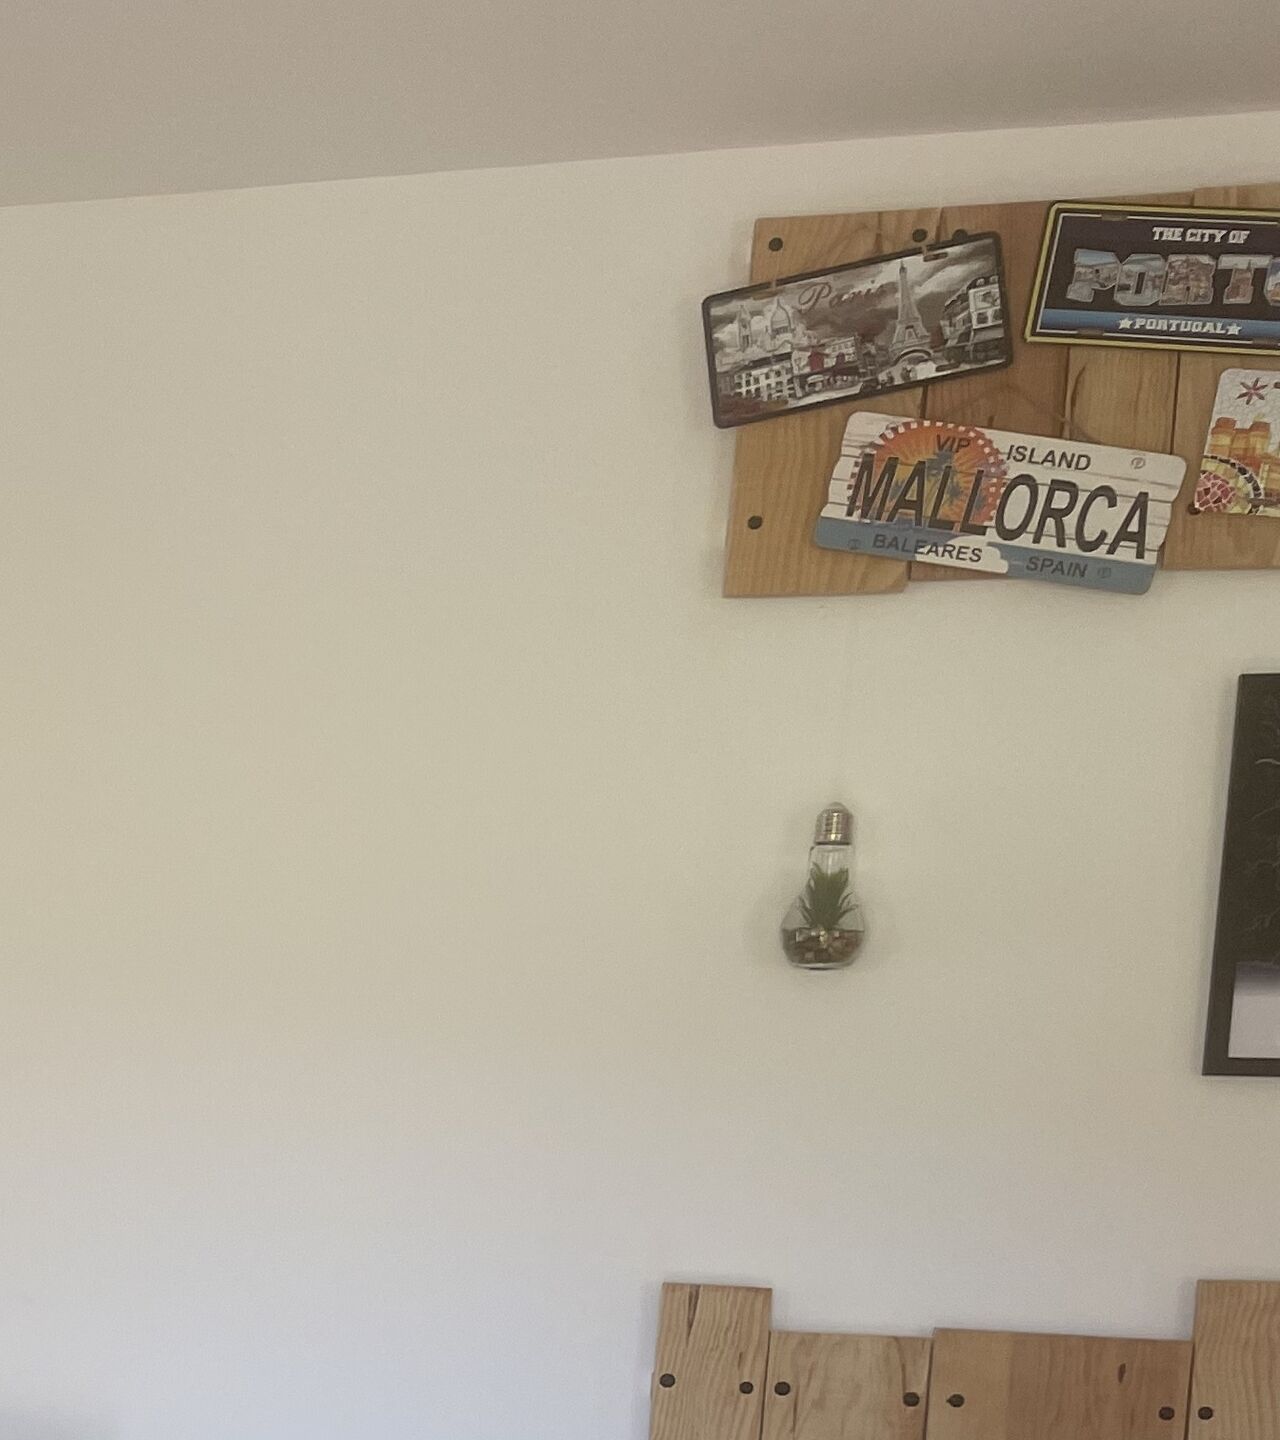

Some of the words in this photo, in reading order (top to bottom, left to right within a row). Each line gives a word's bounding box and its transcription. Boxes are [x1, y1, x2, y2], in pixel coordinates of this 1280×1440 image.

[1152, 226, 1182, 242] THE
[1185, 228, 1227, 244] CITY
[1227, 230, 1251, 245] OF
[1135, 317, 1228, 336] PORTUGAL
[936, 434, 972, 453] VIP
[1006, 444, 1092, 471] ISLAND
[846, 452, 1150, 560] MALLORCA
[872, 533, 983, 563] BALEARES
[1026, 555, 1089, 578] SPAIN
